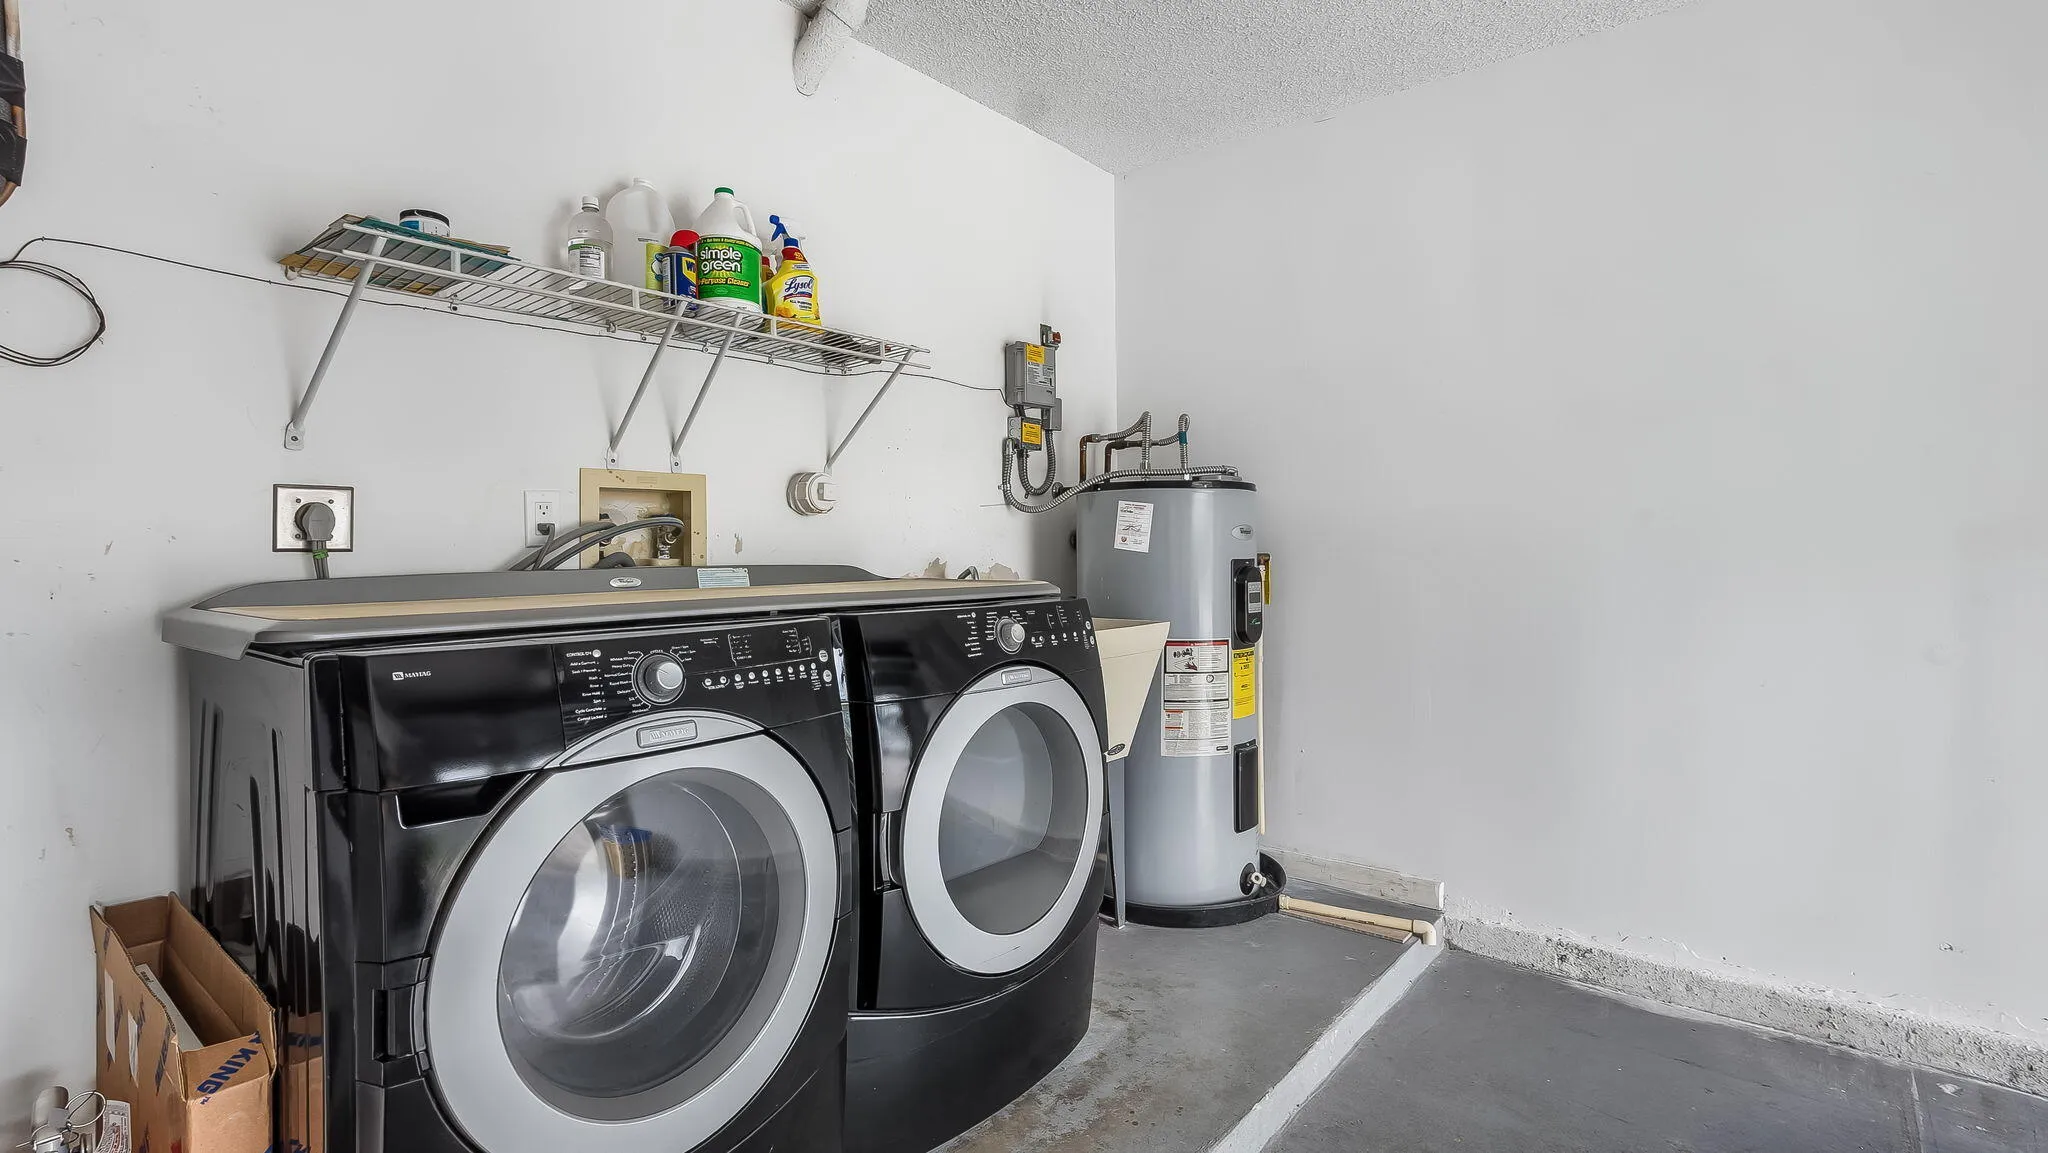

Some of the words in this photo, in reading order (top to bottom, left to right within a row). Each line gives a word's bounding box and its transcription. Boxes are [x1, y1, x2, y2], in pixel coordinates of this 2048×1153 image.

[700, 246, 742, 262] simple
[701, 260, 741, 274] green
[784, 278, 814, 294] Lysol
[196, 1047, 259, 1095] KING
